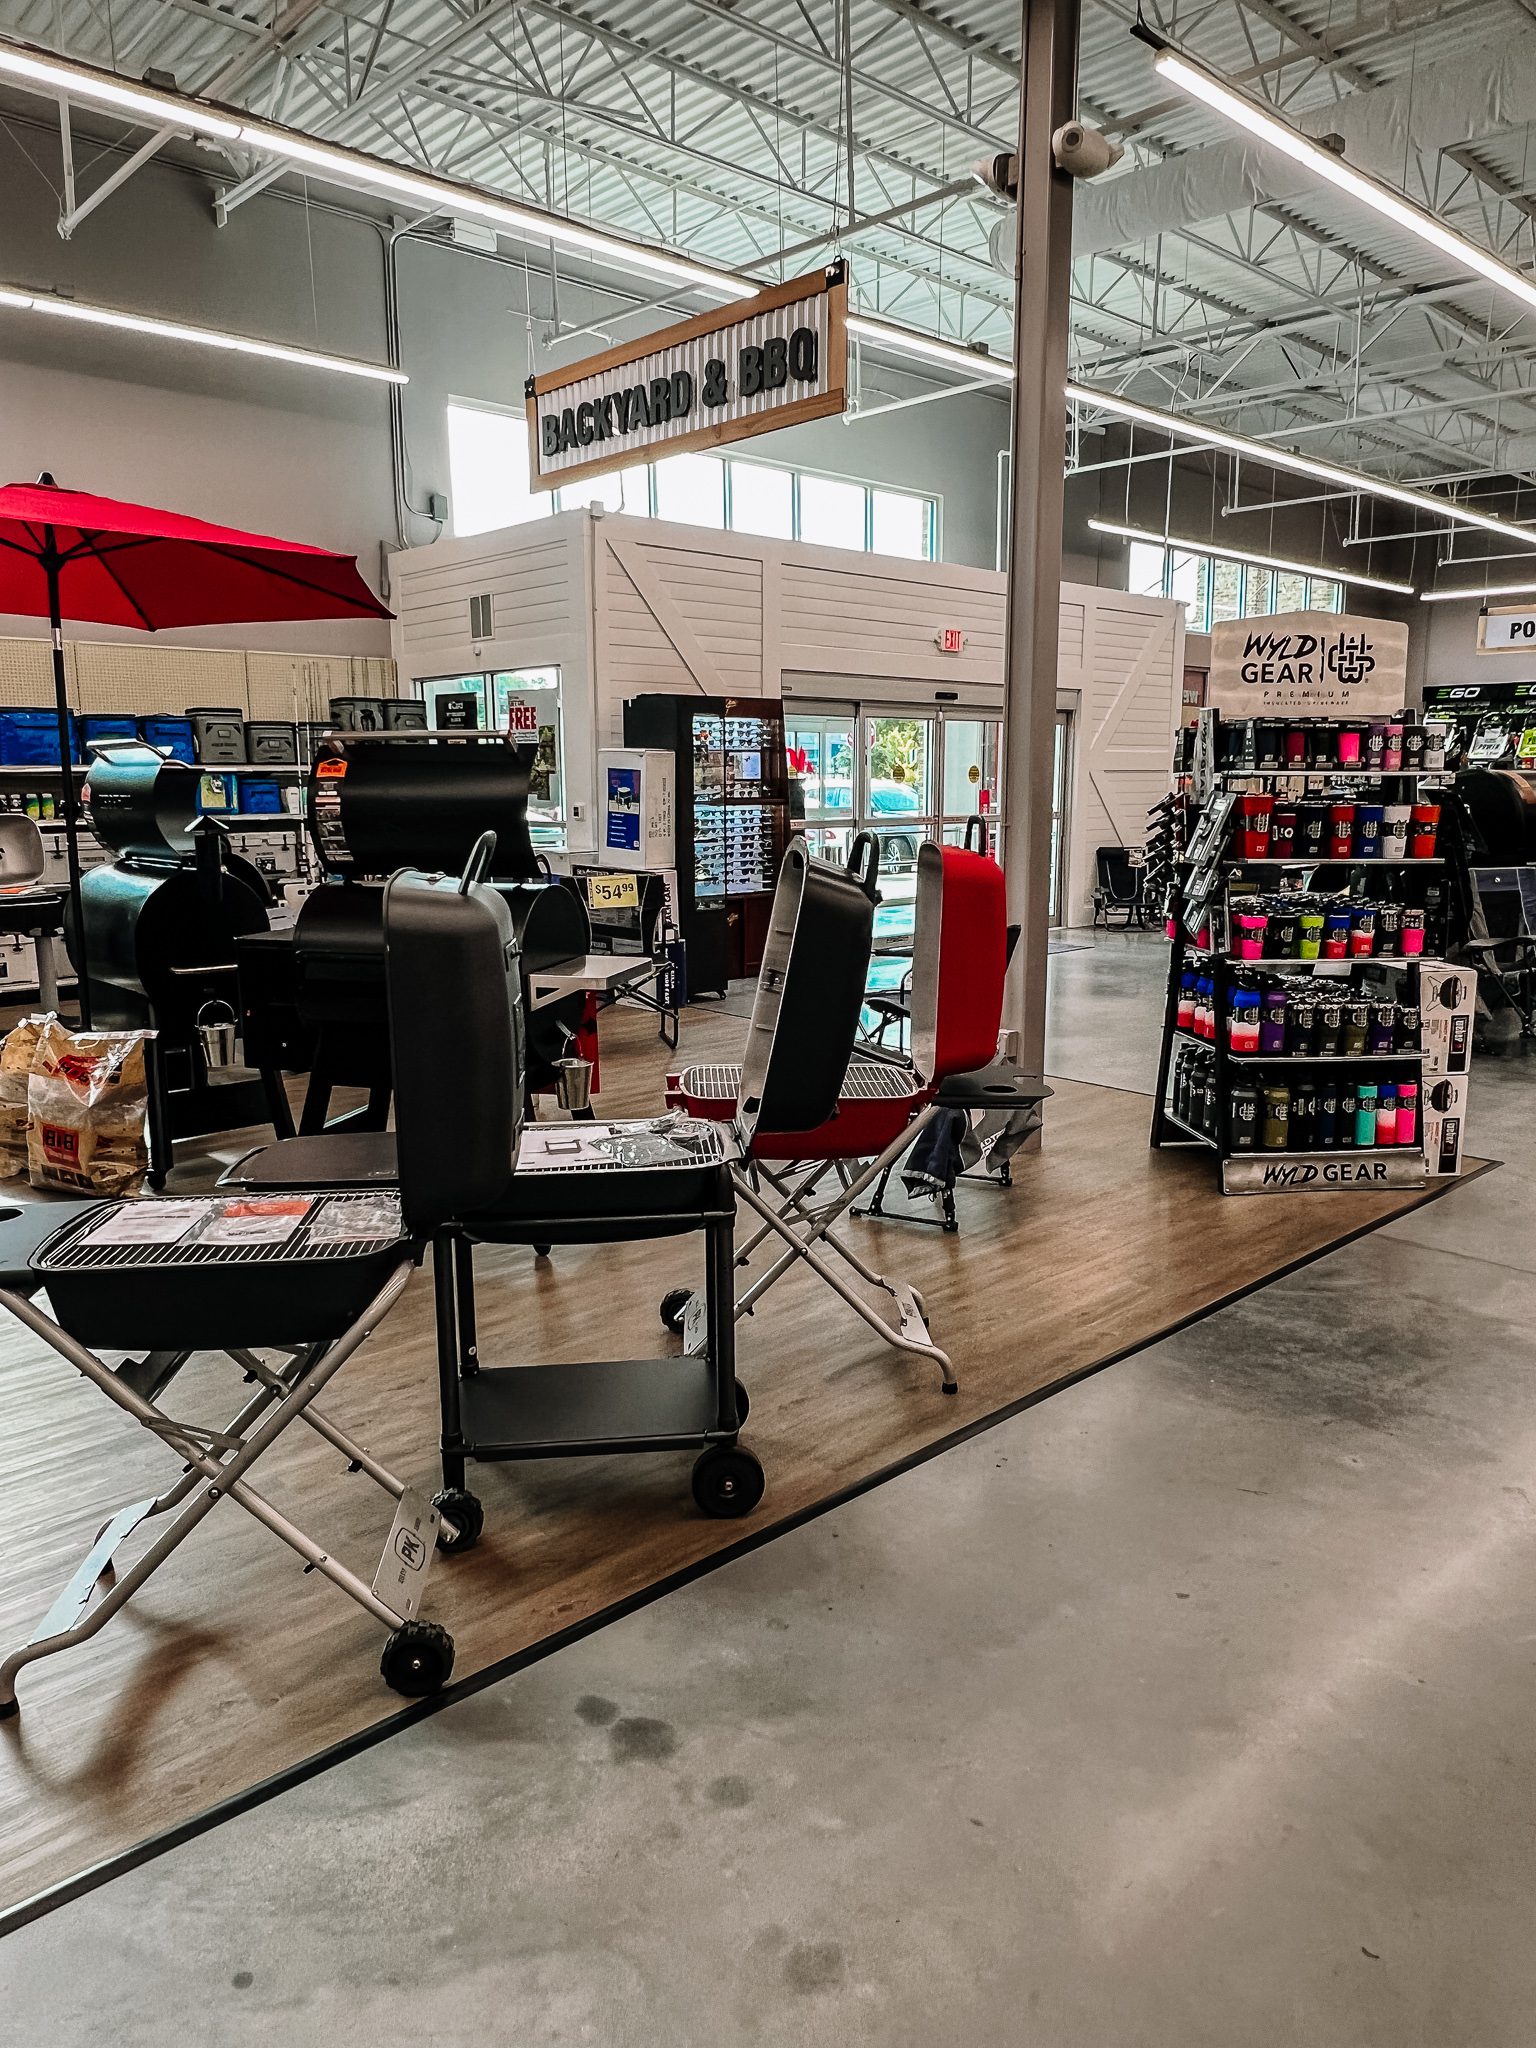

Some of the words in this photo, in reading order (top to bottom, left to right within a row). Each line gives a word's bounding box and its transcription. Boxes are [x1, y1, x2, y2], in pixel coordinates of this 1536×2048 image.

[542, 371, 692, 457] BACKYARD
[702, 359, 728, 408] &
[739, 327, 819, 398] BBQ
[945, 630, 961, 650] EXIT
[1242, 630, 1318, 661] WYLD
[1241, 663, 1313, 683] GEAR
[1436, 687, 1481, 698] EGO
[509, 707, 537, 730] FREE
[1263, 1163, 1319, 1187] WYLD
[1323, 1162, 1387, 1181] GEAR
[401, 1534, 420, 1564] PK
